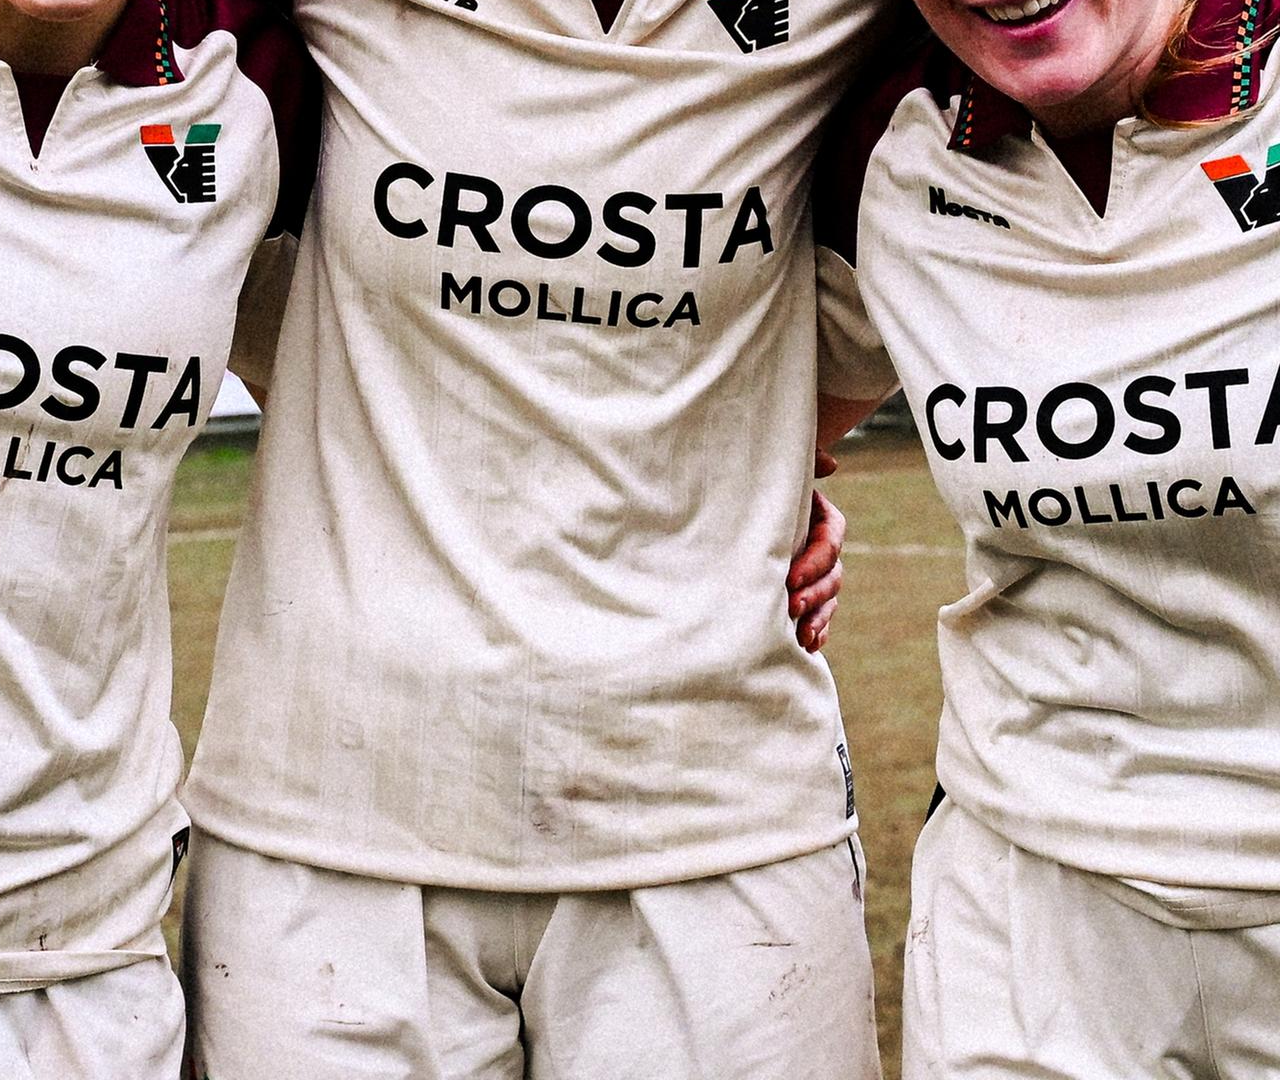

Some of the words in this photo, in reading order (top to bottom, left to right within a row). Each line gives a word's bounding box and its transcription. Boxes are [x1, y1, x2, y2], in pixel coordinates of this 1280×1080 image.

[372, 162, 774, 268] CROSTA
[440, 272, 701, 328] MOLLICA
[983, 476, 1257, 529] MOLLICA
